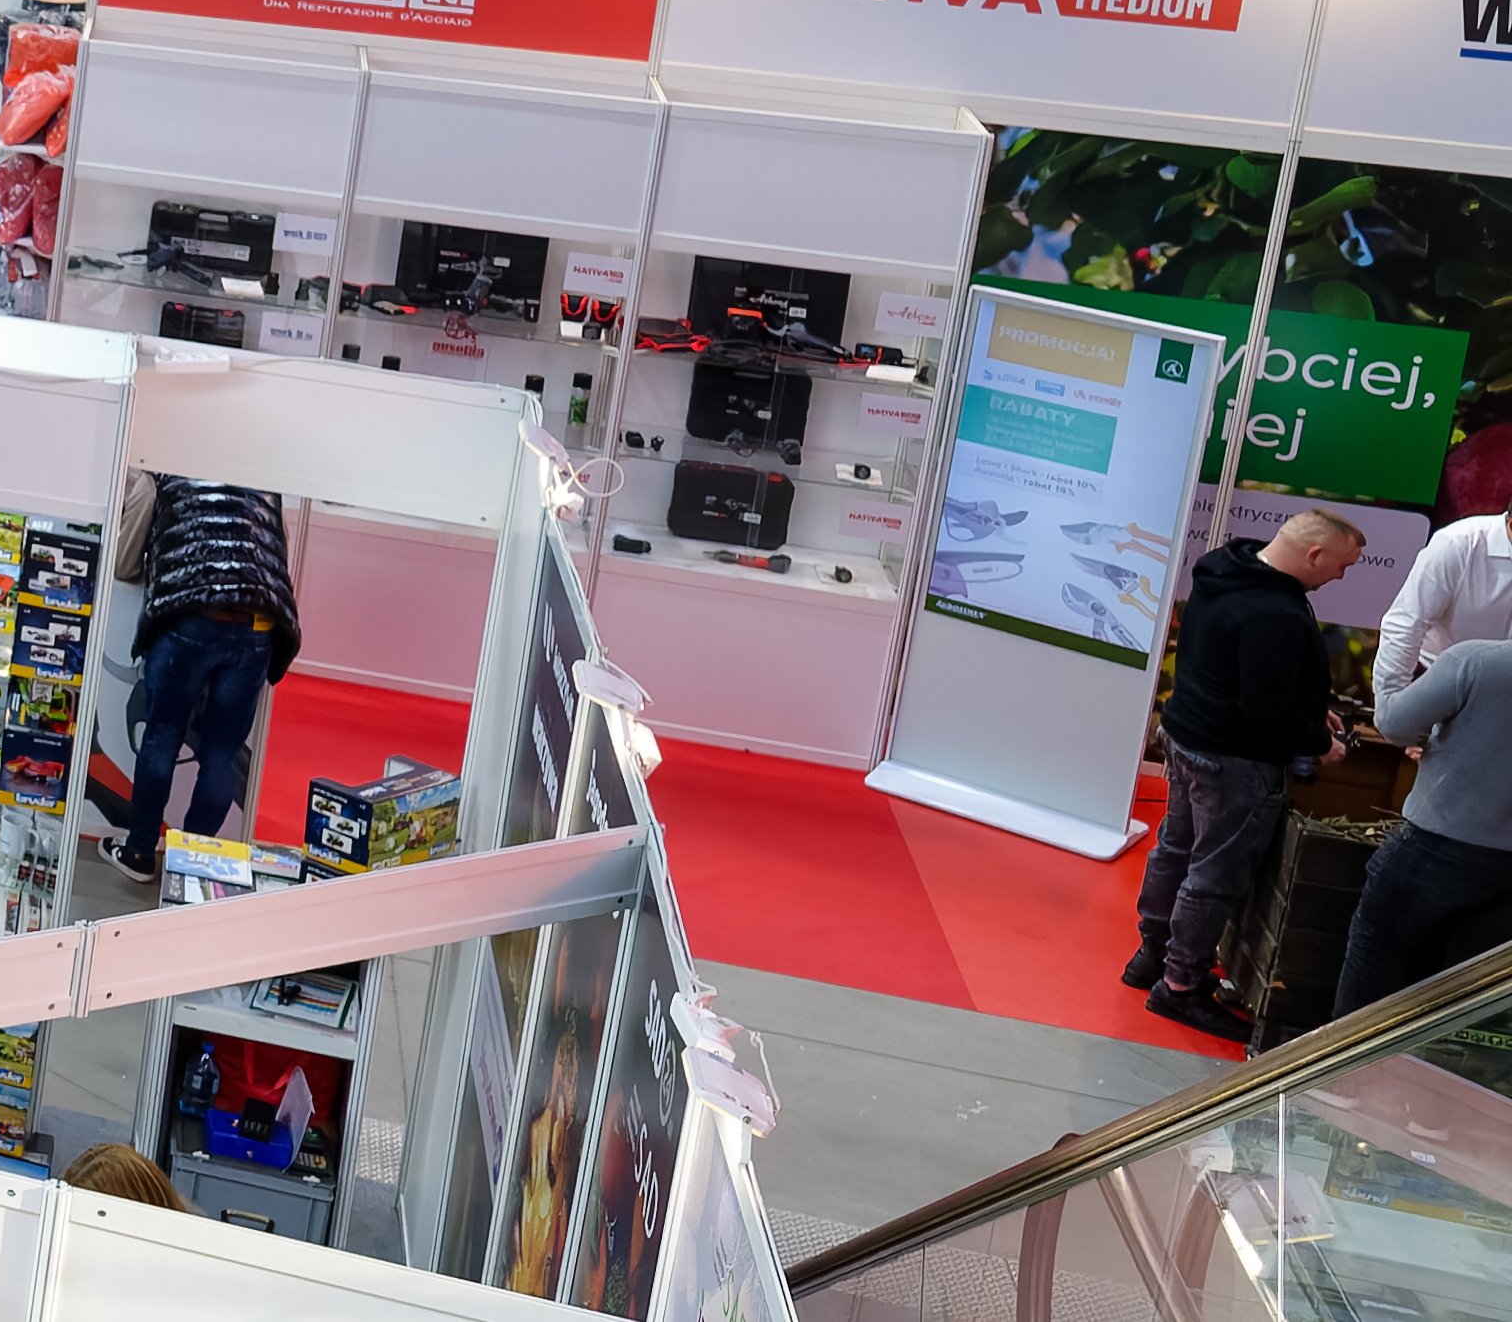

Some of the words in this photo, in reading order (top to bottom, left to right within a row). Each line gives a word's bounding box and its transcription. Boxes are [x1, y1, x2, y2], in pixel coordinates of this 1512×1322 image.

[989, 393, 1077, 428] RABATY
[1206, 398, 1307, 461] iej
[16, 792, 57, 808] bruder
